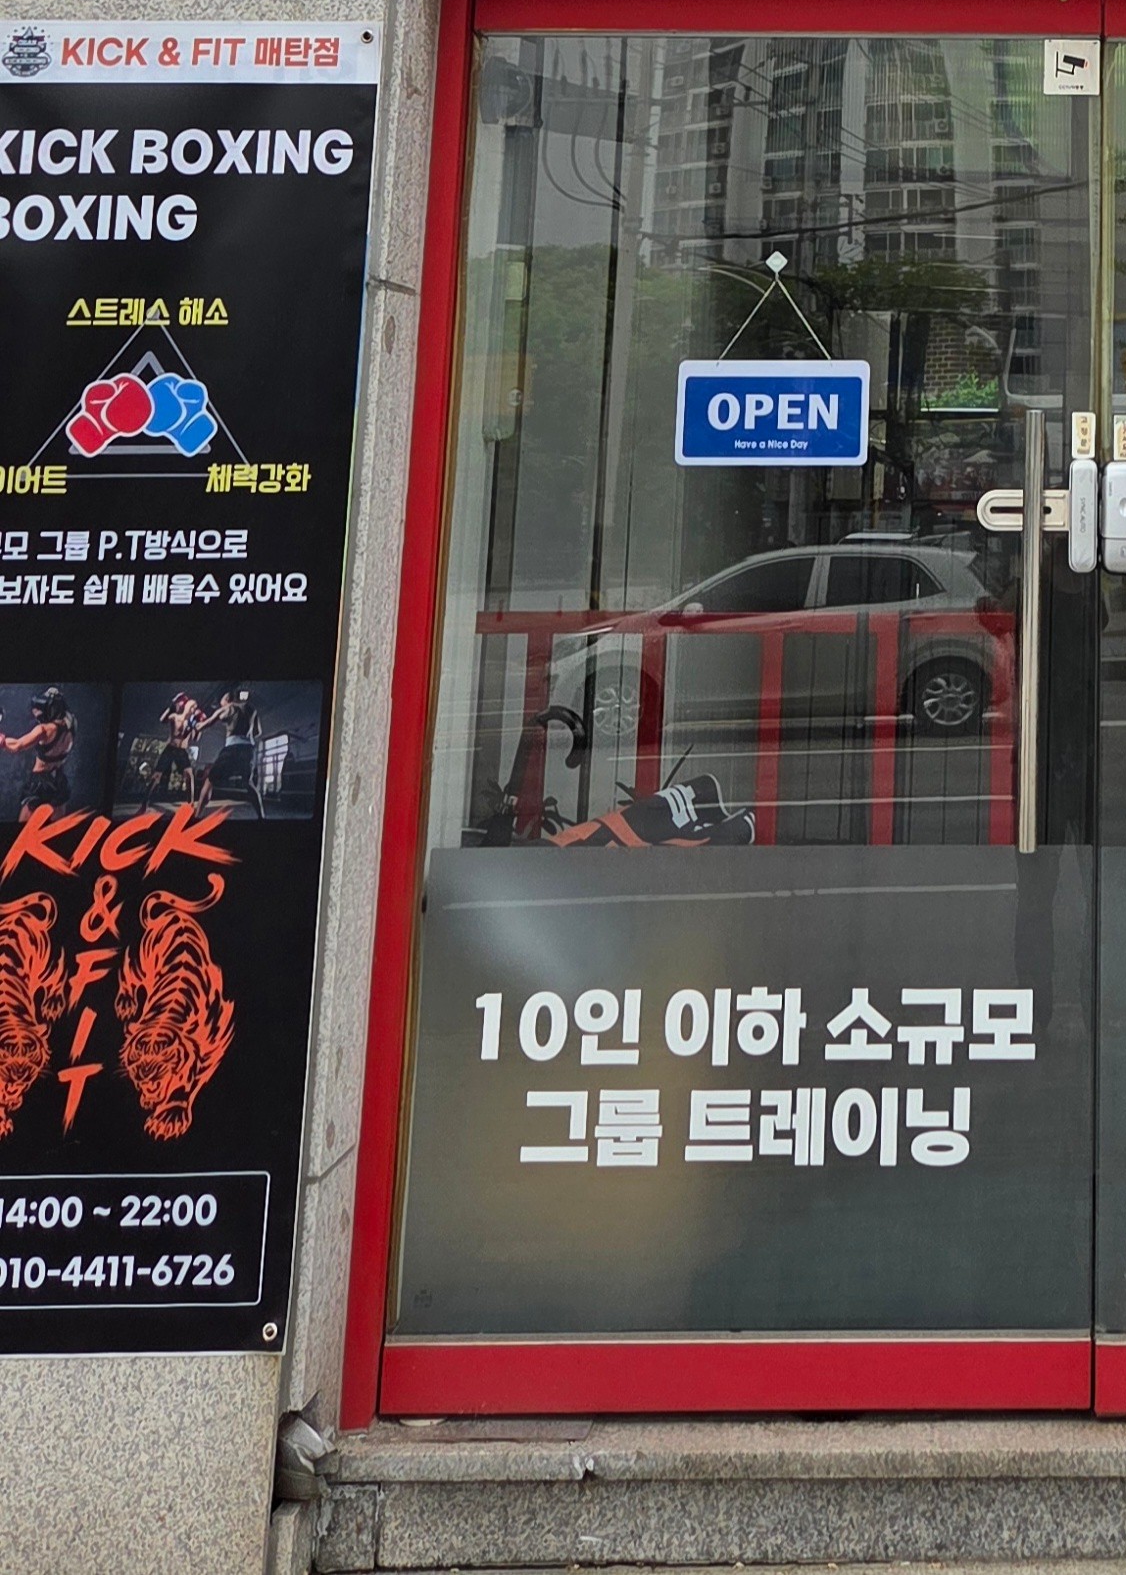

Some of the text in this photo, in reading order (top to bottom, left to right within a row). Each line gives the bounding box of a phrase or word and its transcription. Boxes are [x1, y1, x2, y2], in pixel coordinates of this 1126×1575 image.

[60, 36, 150, 67] KICK
[157, 37, 181, 66] &
[191, 36, 246, 66] FIT
[254, 36, 340, 68] 매탄점
[130, 128, 354, 176] BOXING
[0, 193, 198, 242] OXING
[66, 297, 229, 326] 스트레스 해소
[707, 392, 839, 431] OPEN
[734, 439, 808, 451] Have a Nice Day
[205, 463, 312, 494] 체력강화
[0, 529, 249, 561] 모 그룹 P.T방식으로
[83, 574, 135, 605] 쉽게
[142, 574, 220, 605] 배울수
[228, 573, 309, 604] 있어요
[3, 801, 241, 877] KICK
[475, 986, 1036, 1066] 10인 이하 소규모
[520, 1086, 971, 1167] 그룹 트레이닝
[120, 1193, 218, 1227] 22:00
